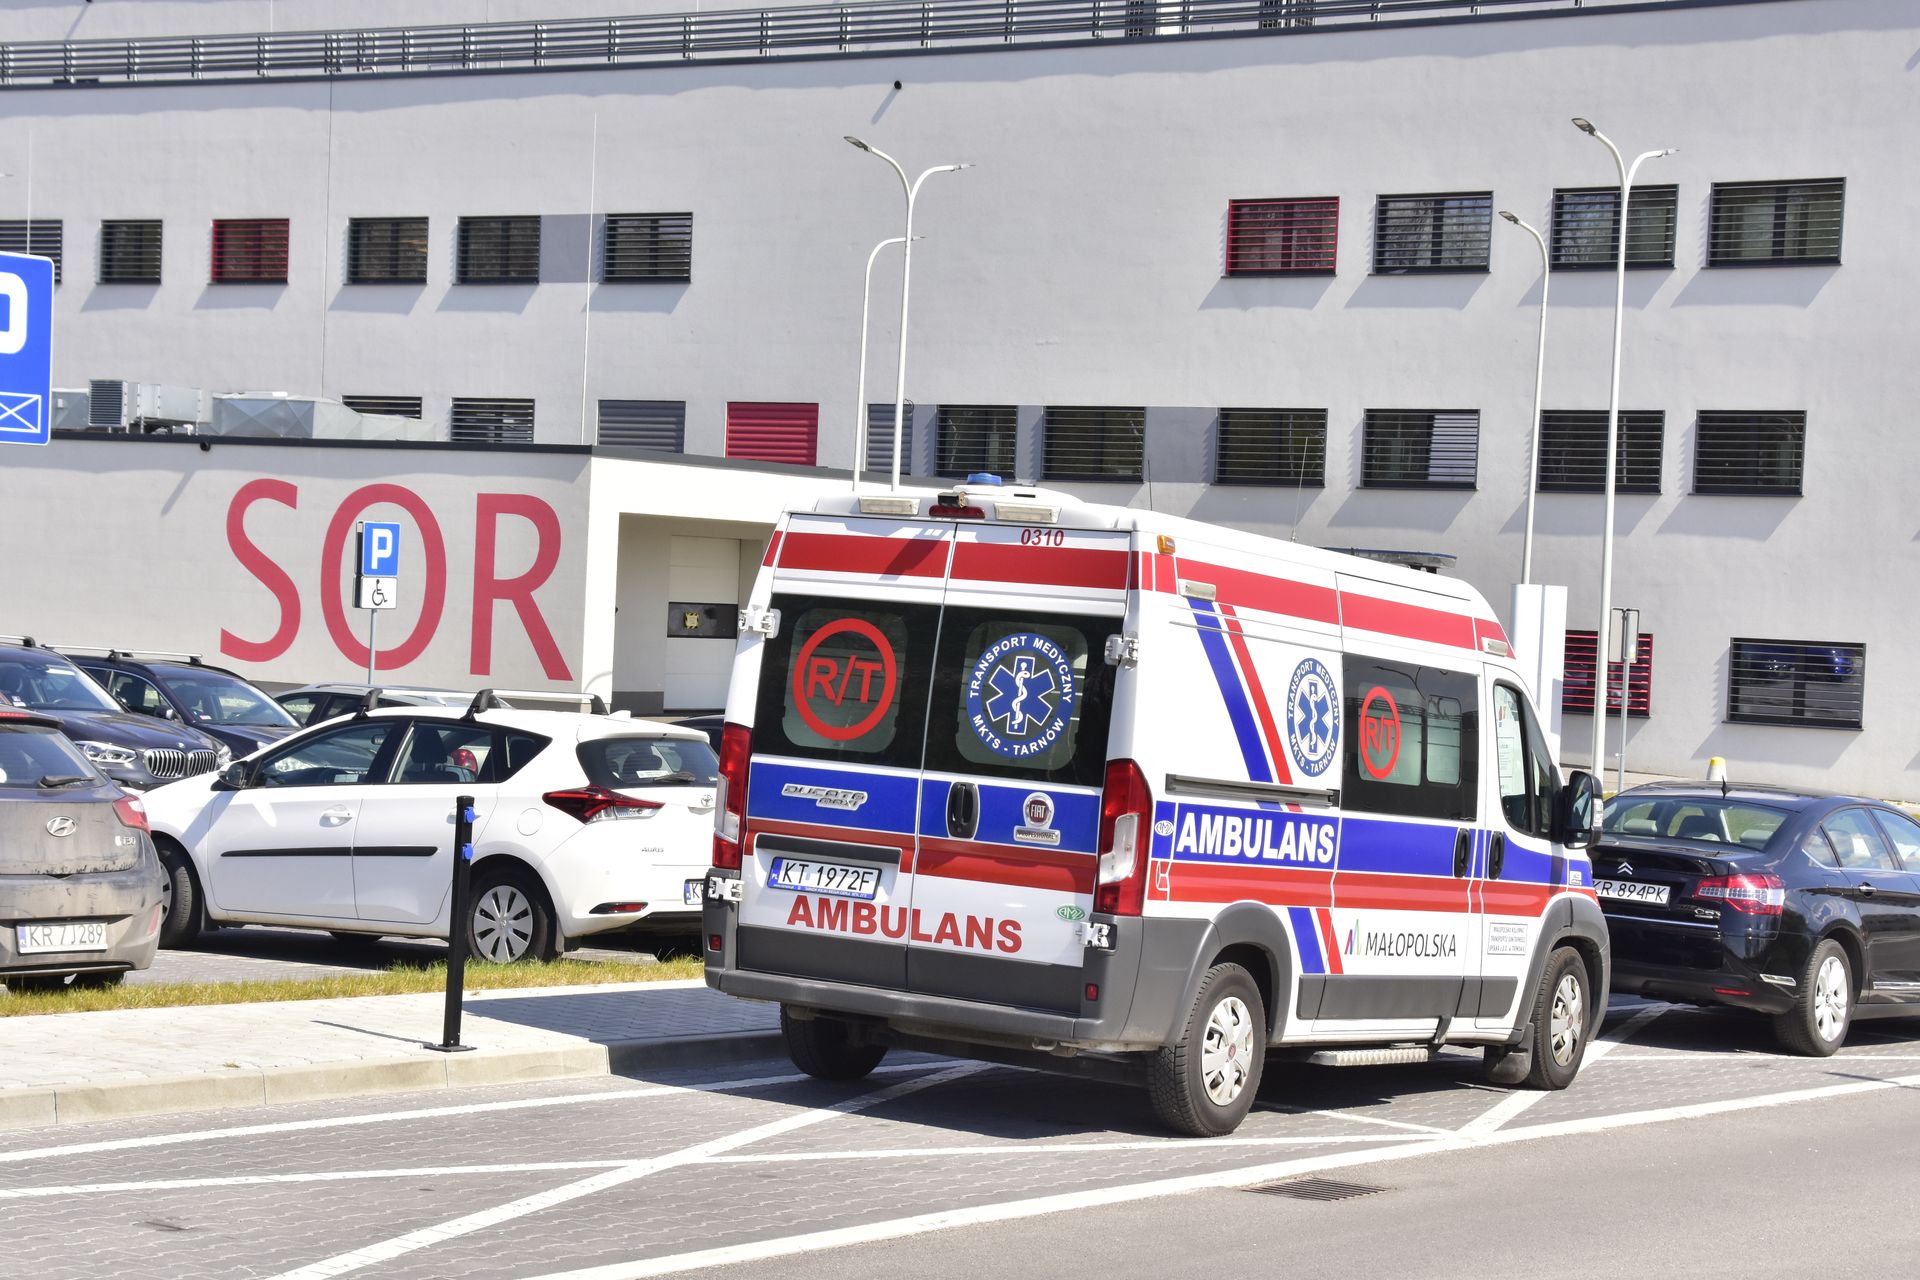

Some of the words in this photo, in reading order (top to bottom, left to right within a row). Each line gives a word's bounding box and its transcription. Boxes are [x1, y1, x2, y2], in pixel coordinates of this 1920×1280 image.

[371, 528, 393, 570] P
[1020, 528, 1065, 547] 0310
[220, 478, 574, 681] SOR
[806, 655, 883, 706] R/T
[970, 636, 1028, 698] TRANSPORT
[1032, 637, 1073, 704] MEDYCZNY
[1288, 661, 1314, 719] TRANSPORT
[1316, 664, 1339, 726] MEDYCZNY
[973, 714, 1001, 749] MKTS
[1012, 717, 1064, 756] TARNÓW
[1290, 733, 1305, 767] MKTS
[1365, 713, 1396, 754] R/T
[1030, 804, 1046, 818] FIAT
[1176, 812, 1334, 863] AMBULANS
[782, 862, 809, 884] KT
[816, 865, 873, 891] 1972F
[1617, 883, 1667, 902] 894PK
[29, 926, 53, 947] KR
[60, 925, 104, 945] 7J289
[787, 895, 1023, 953] AMBULANS
[1365, 932, 1457, 957] MAŁOPOLSKA
